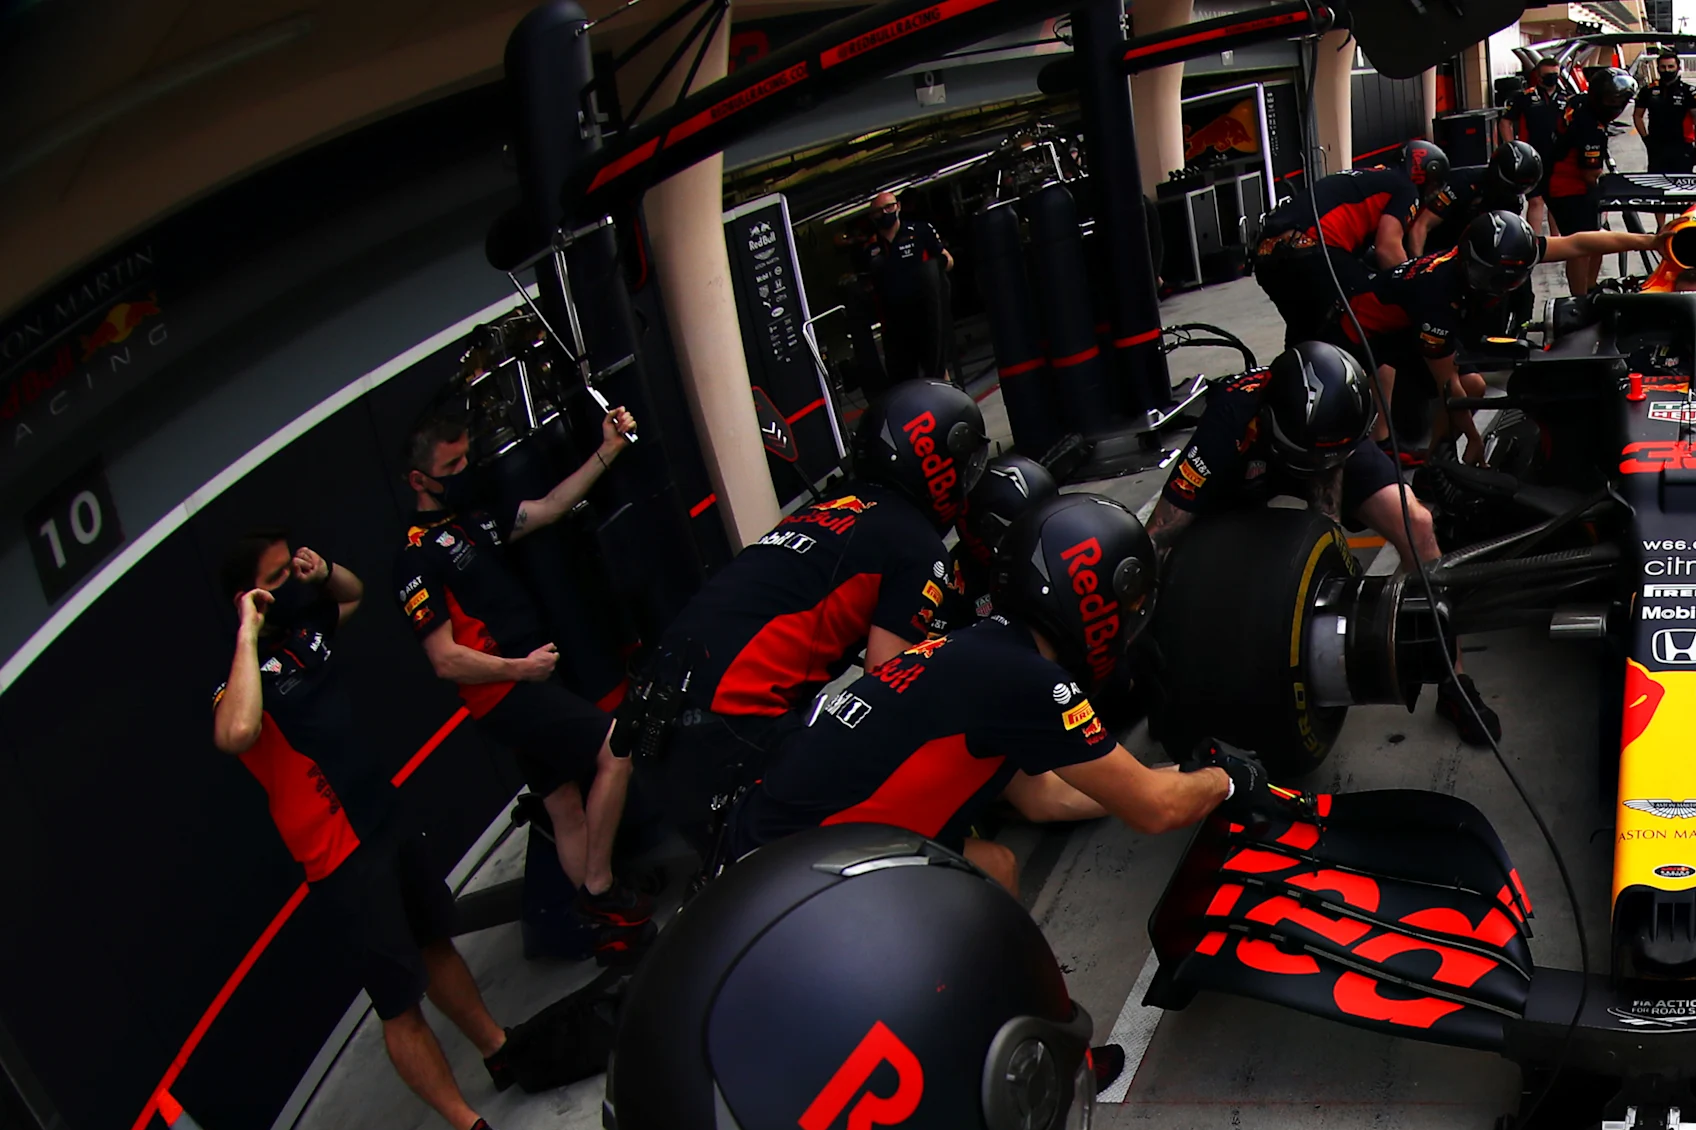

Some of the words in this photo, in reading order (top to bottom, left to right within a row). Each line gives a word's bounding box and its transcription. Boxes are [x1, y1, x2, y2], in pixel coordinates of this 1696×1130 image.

[1192, 456, 1212, 477] AT&T
[38, 489, 103, 570] 10
[1617, 829, 1667, 844] ASTON
[1651, 1007, 1686, 1016] ROAD
